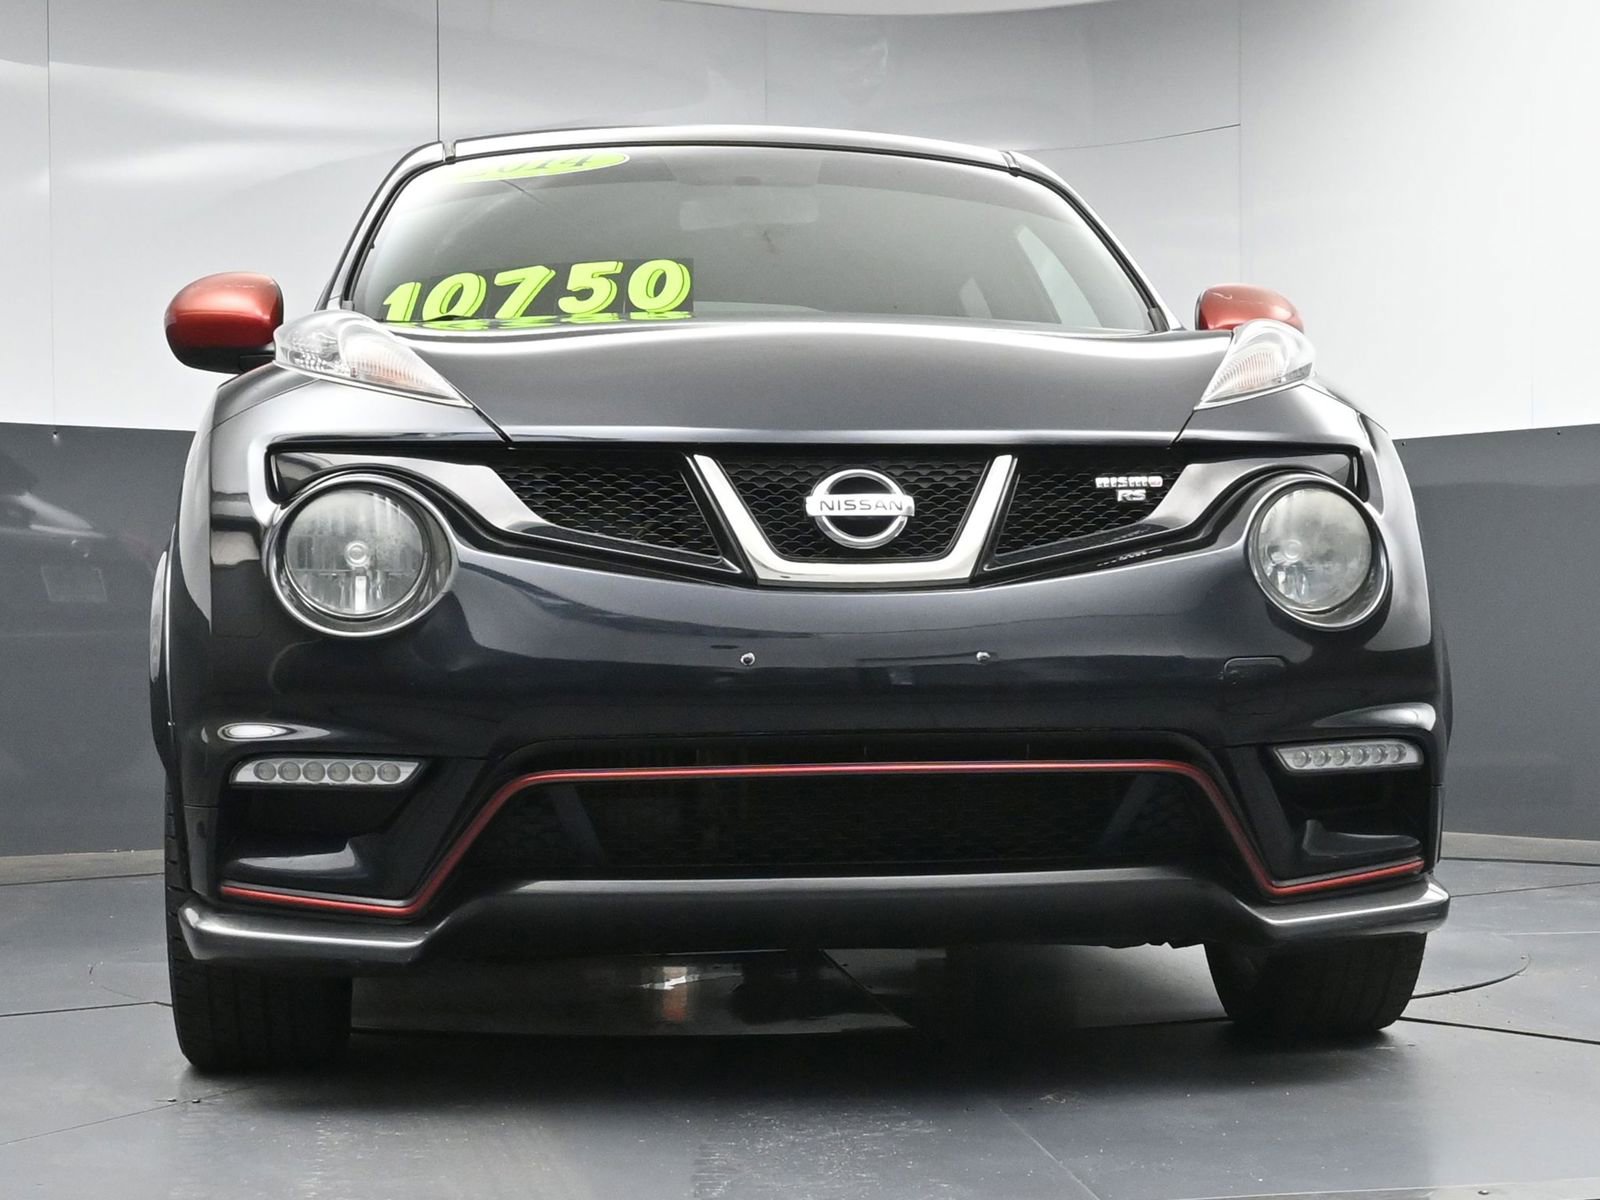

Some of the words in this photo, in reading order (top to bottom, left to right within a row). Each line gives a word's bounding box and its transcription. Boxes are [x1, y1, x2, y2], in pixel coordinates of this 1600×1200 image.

[383, 259, 692, 322] 10750
[1117, 489, 1147, 502] RS
[819, 499, 903, 511] NISSAN
